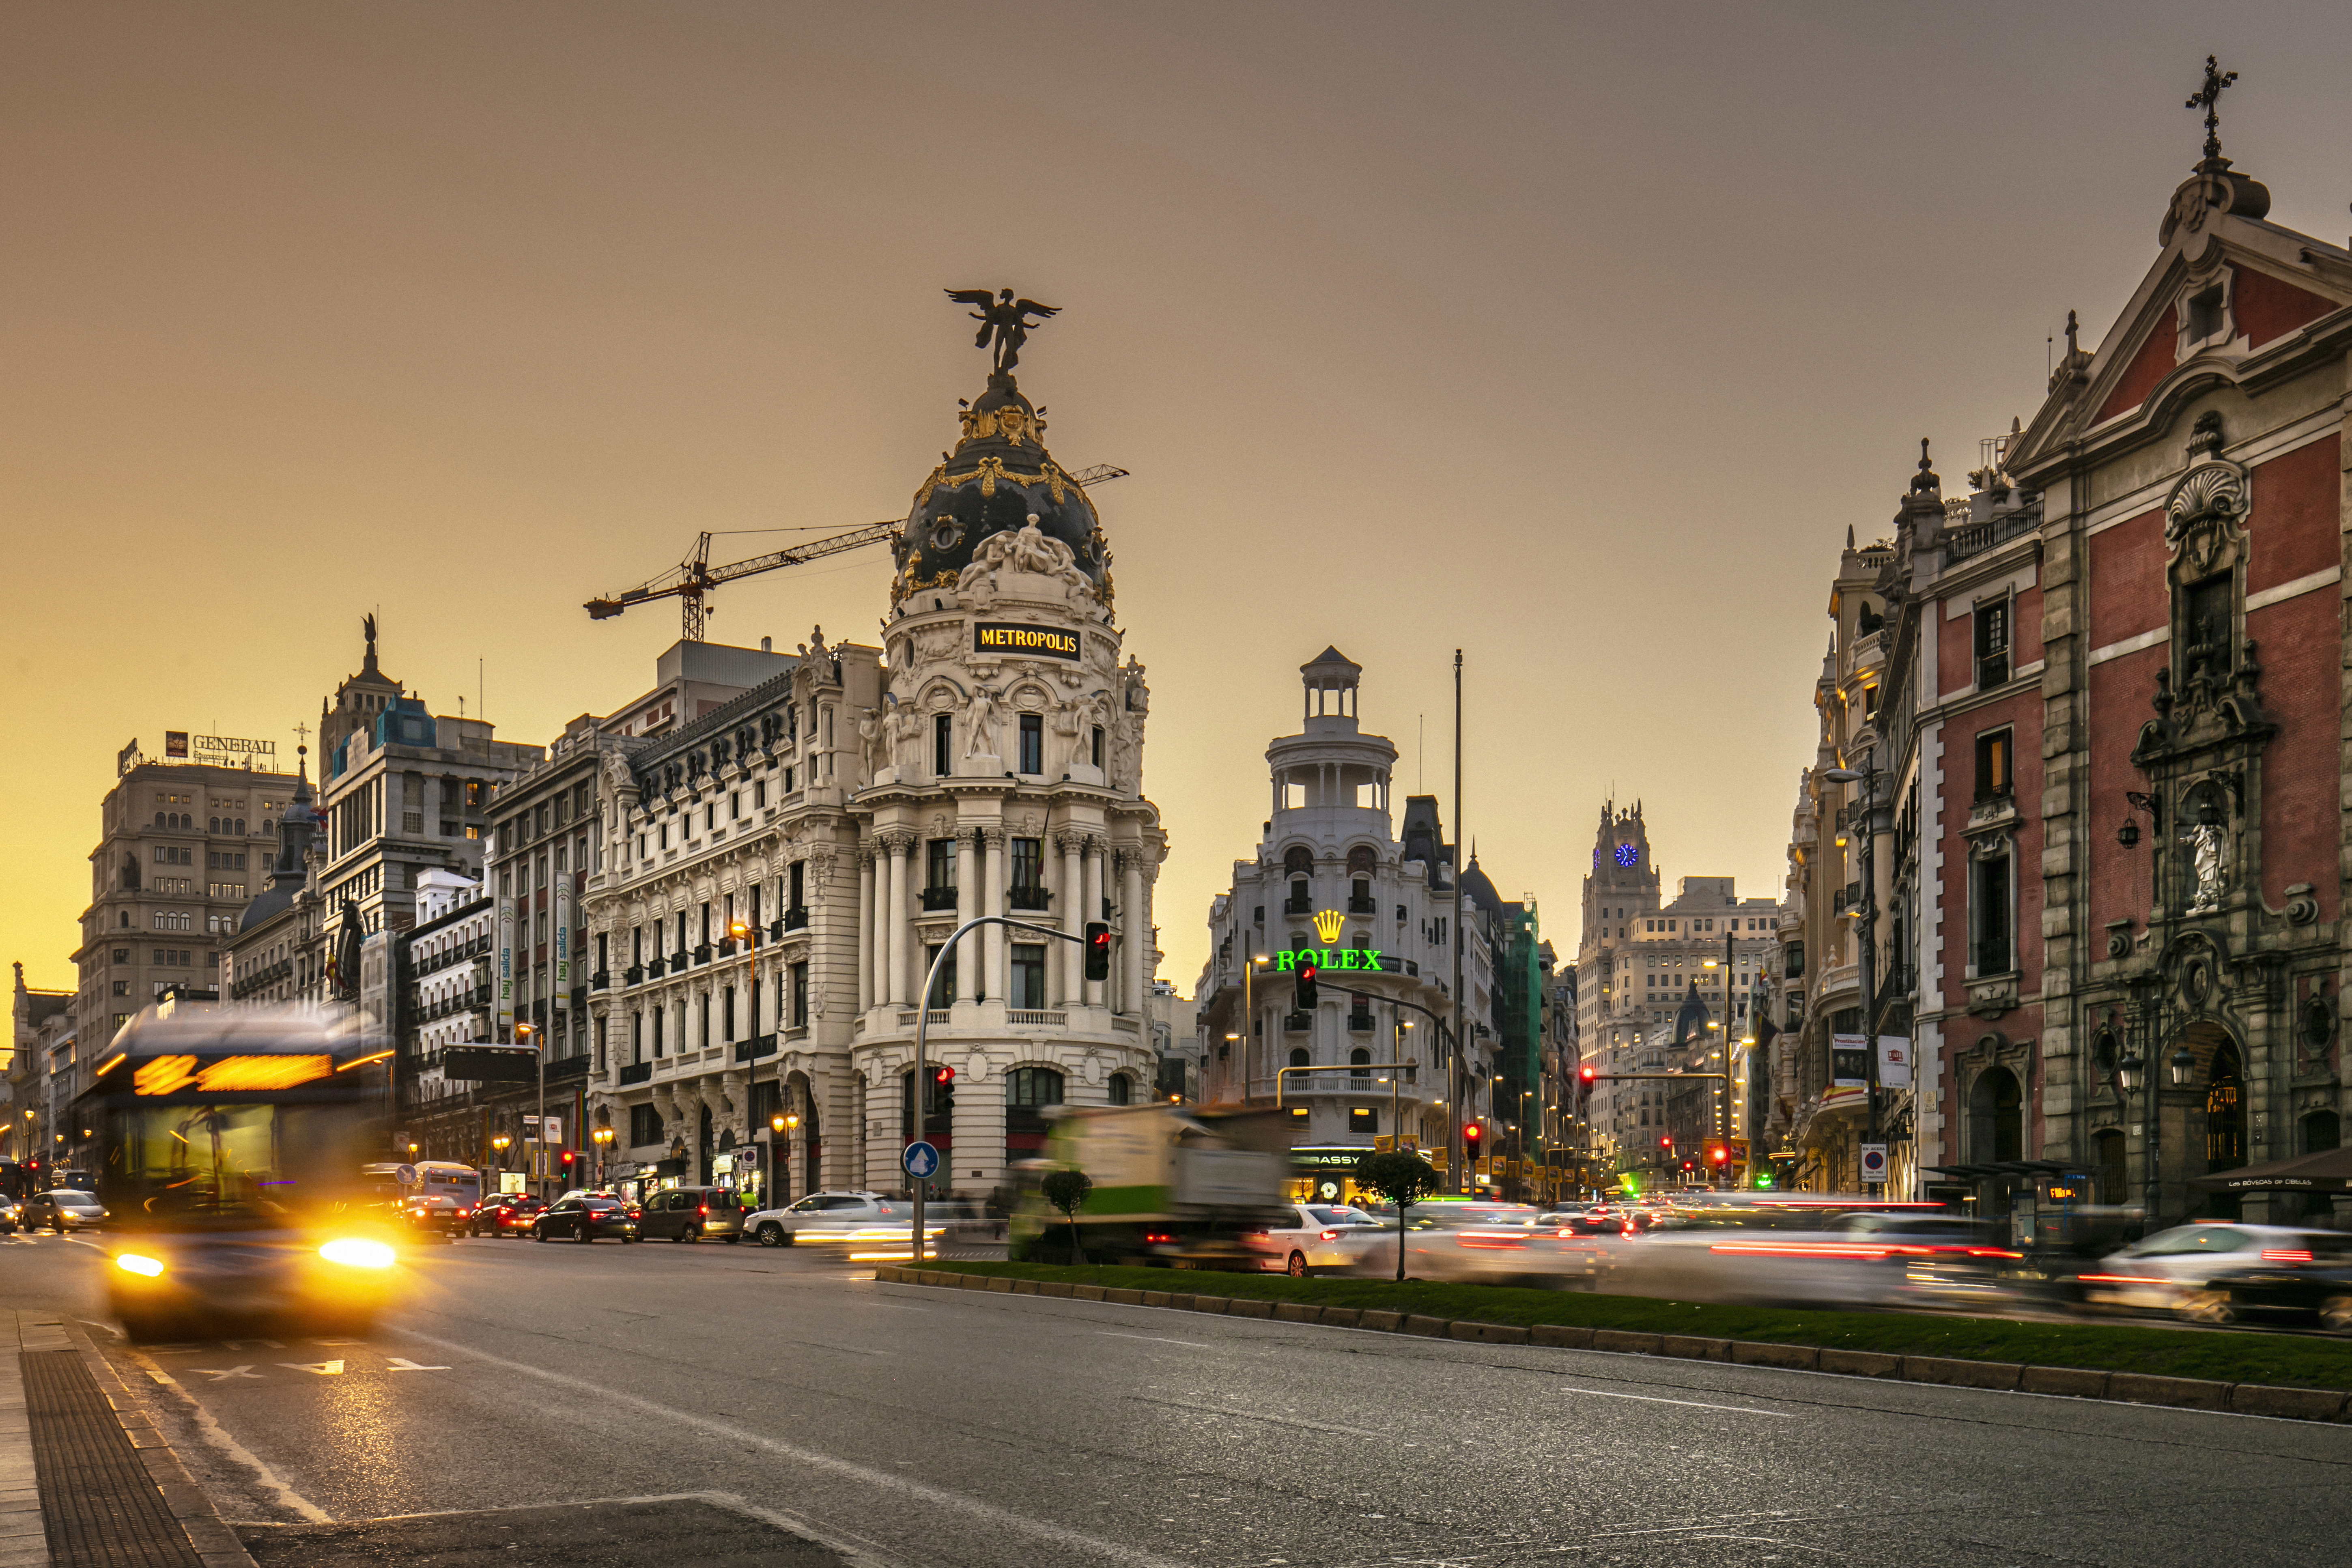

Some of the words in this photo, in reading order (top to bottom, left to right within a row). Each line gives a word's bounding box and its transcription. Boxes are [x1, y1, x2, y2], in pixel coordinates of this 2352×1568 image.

[981, 629, 1076, 652] METROPOLIS
[193, 735, 276, 755] GENERALI
[557, 927, 567, 959] salida
[501, 948, 510, 978] salida
[557, 960, 569, 982] hay
[1276, 949, 1382, 971] ROLEX
[500, 980, 513, 1000] hay
